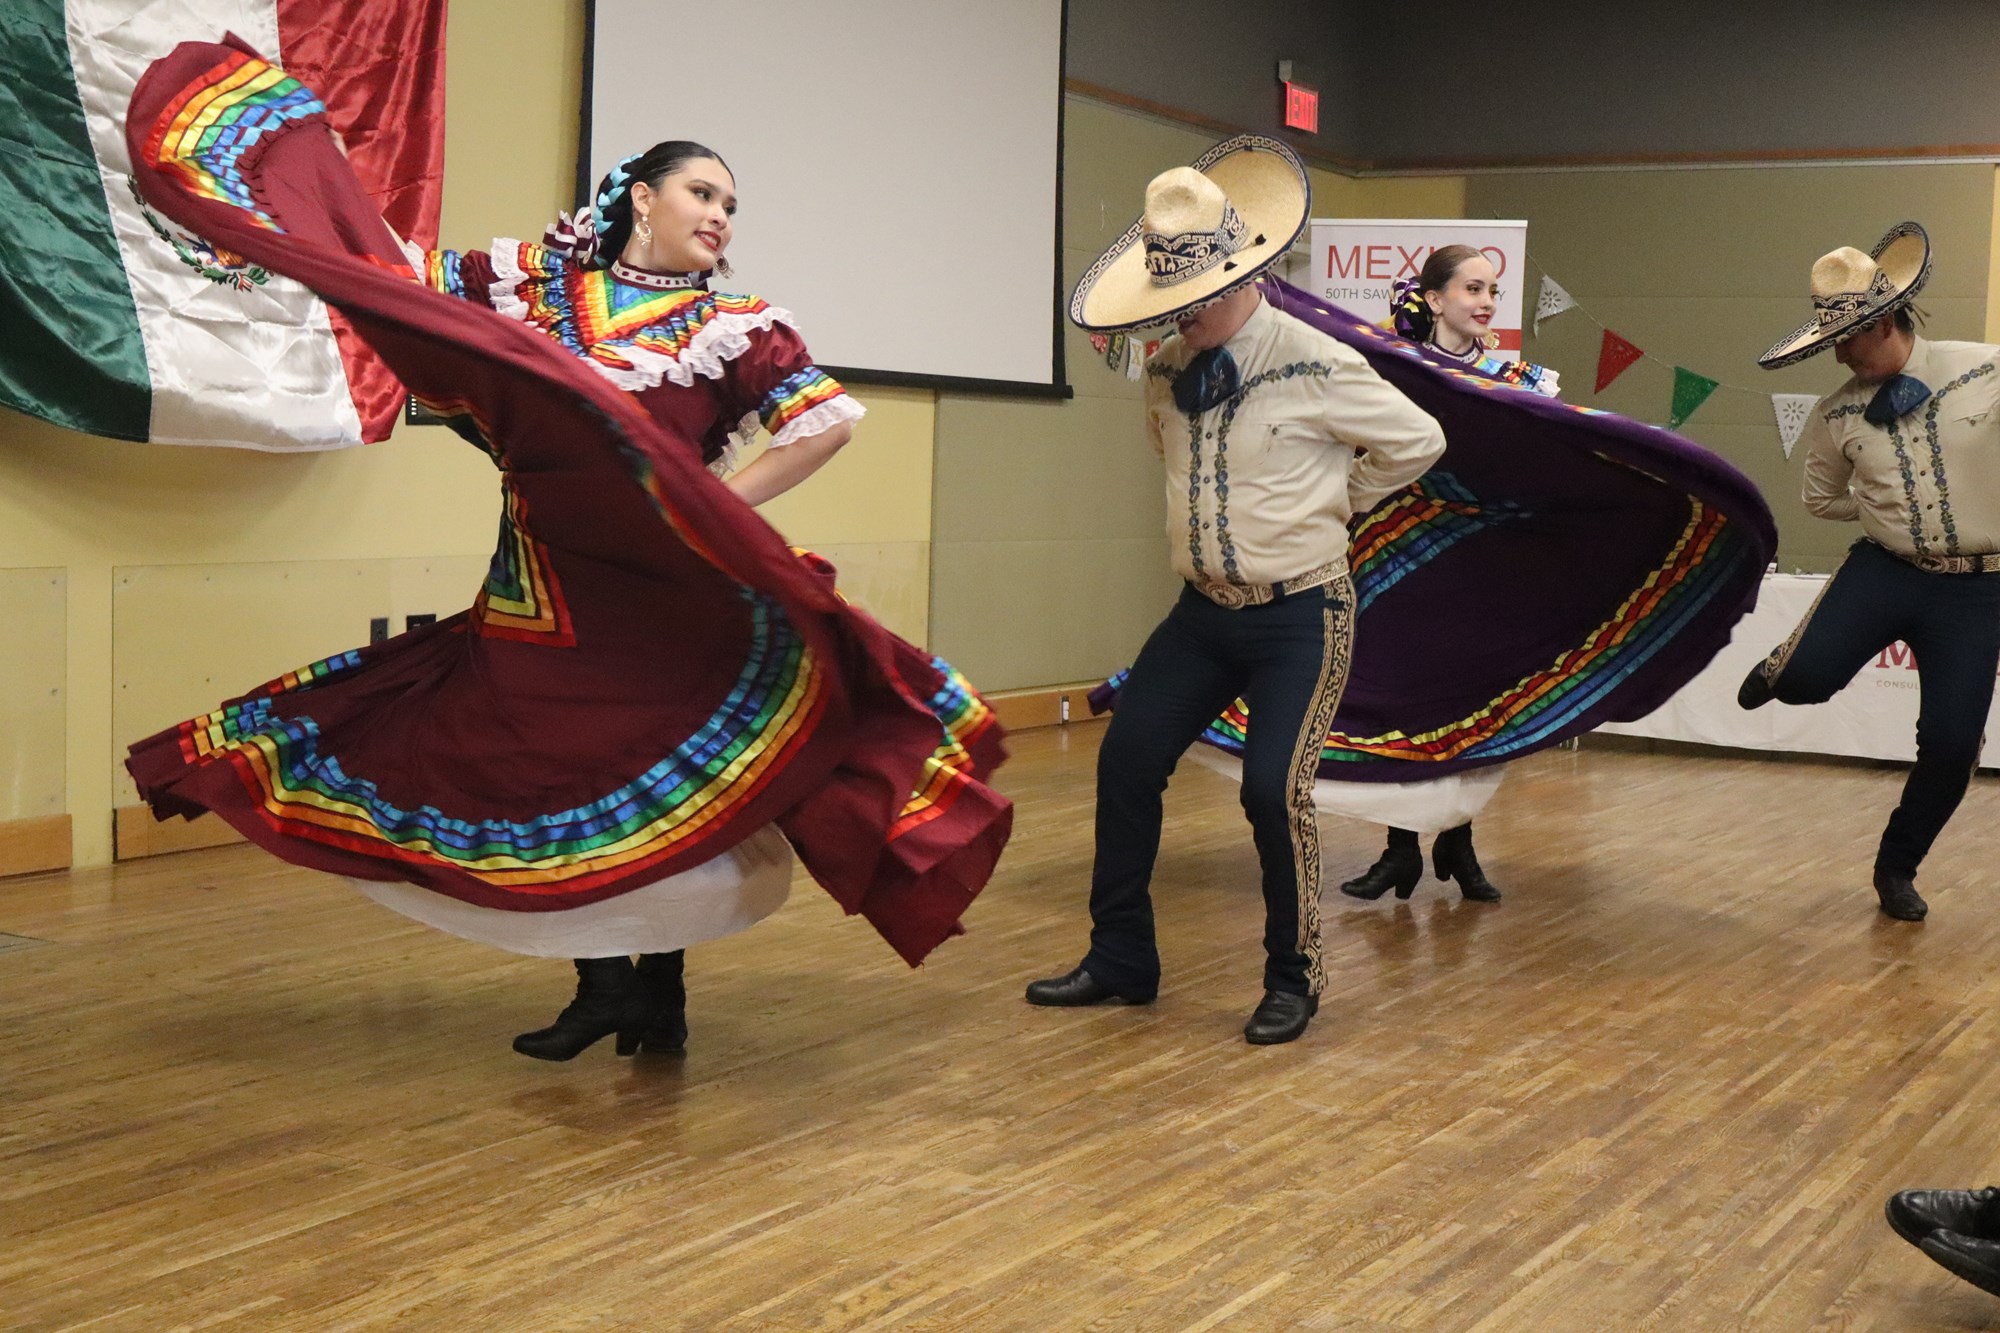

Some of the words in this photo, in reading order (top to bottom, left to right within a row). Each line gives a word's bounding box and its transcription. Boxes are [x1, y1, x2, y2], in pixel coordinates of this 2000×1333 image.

[1327, 245, 1507, 280] MEXO
[1325, 287, 1359, 300] 50TH
[1876, 680, 1920, 690] CONSUL
